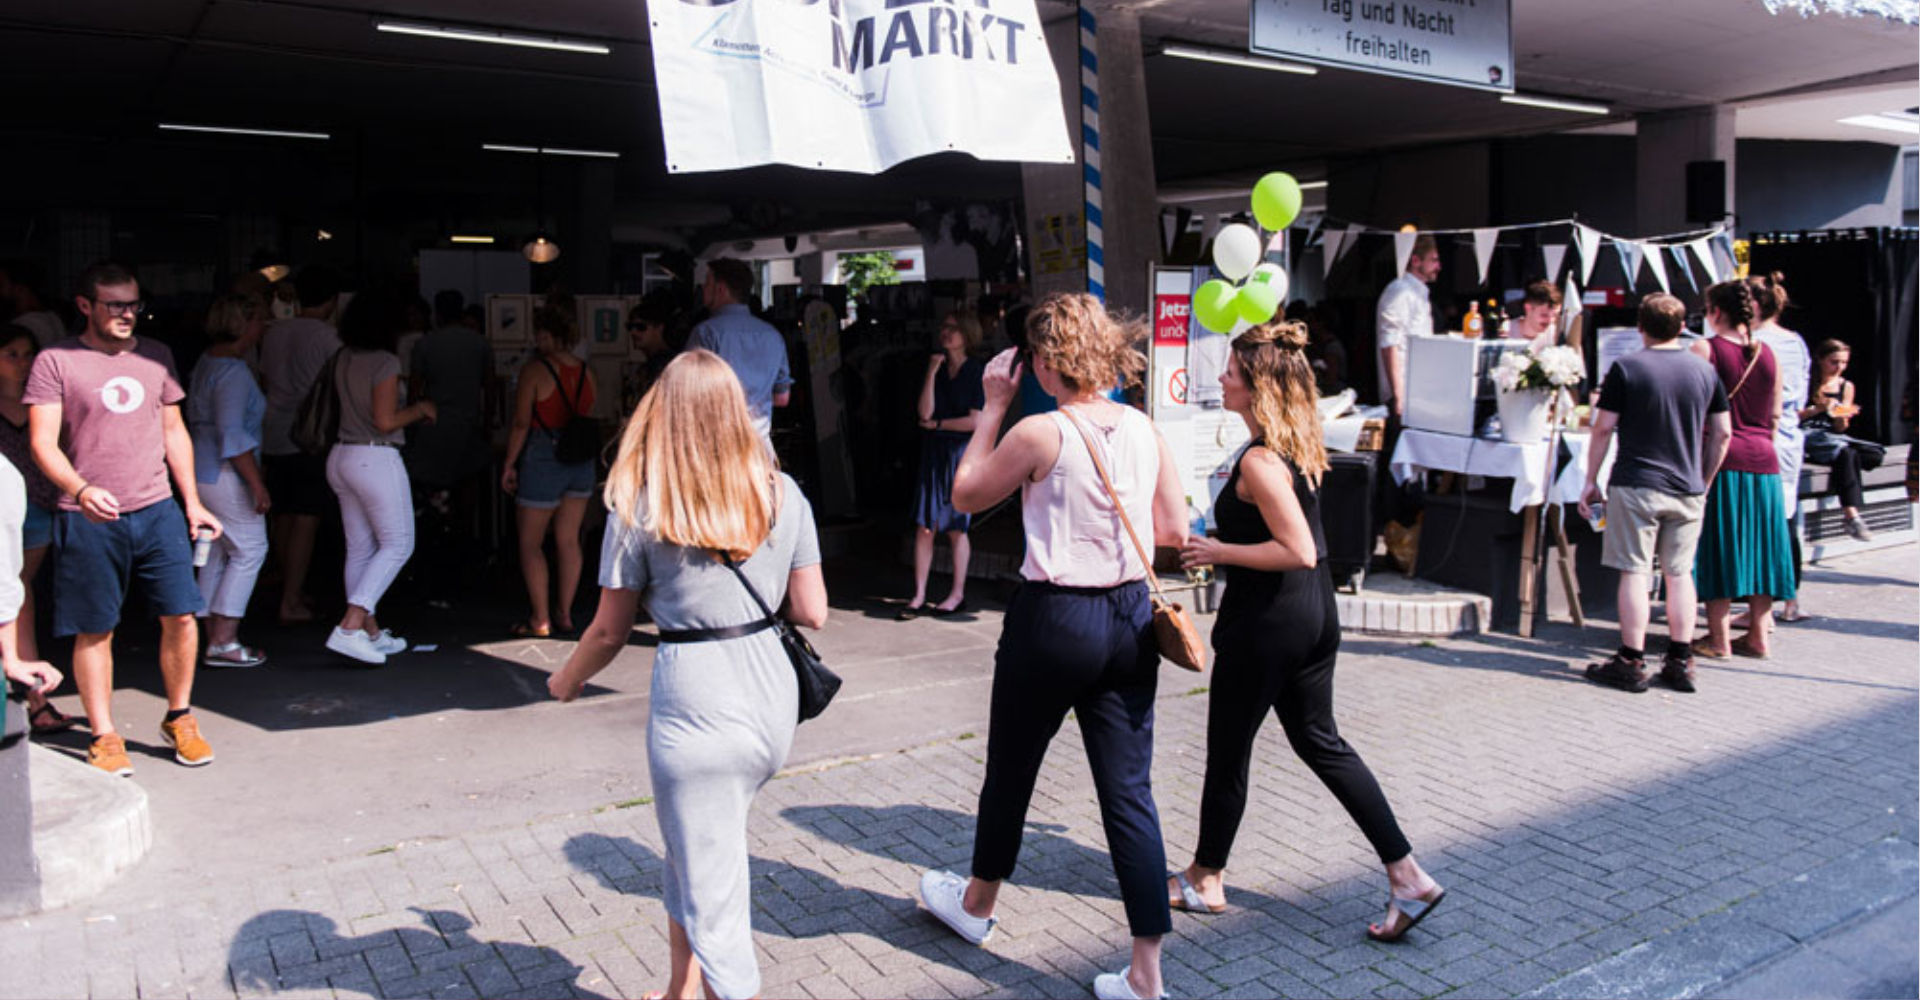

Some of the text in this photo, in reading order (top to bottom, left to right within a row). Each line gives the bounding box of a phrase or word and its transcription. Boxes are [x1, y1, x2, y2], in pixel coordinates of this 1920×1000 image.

[1361, 2, 1395, 24] und
[1403, 4, 1454, 35] Nacht
[831, 7, 1026, 74] MARKT
[1346, 30, 1431, 66] freihalten
